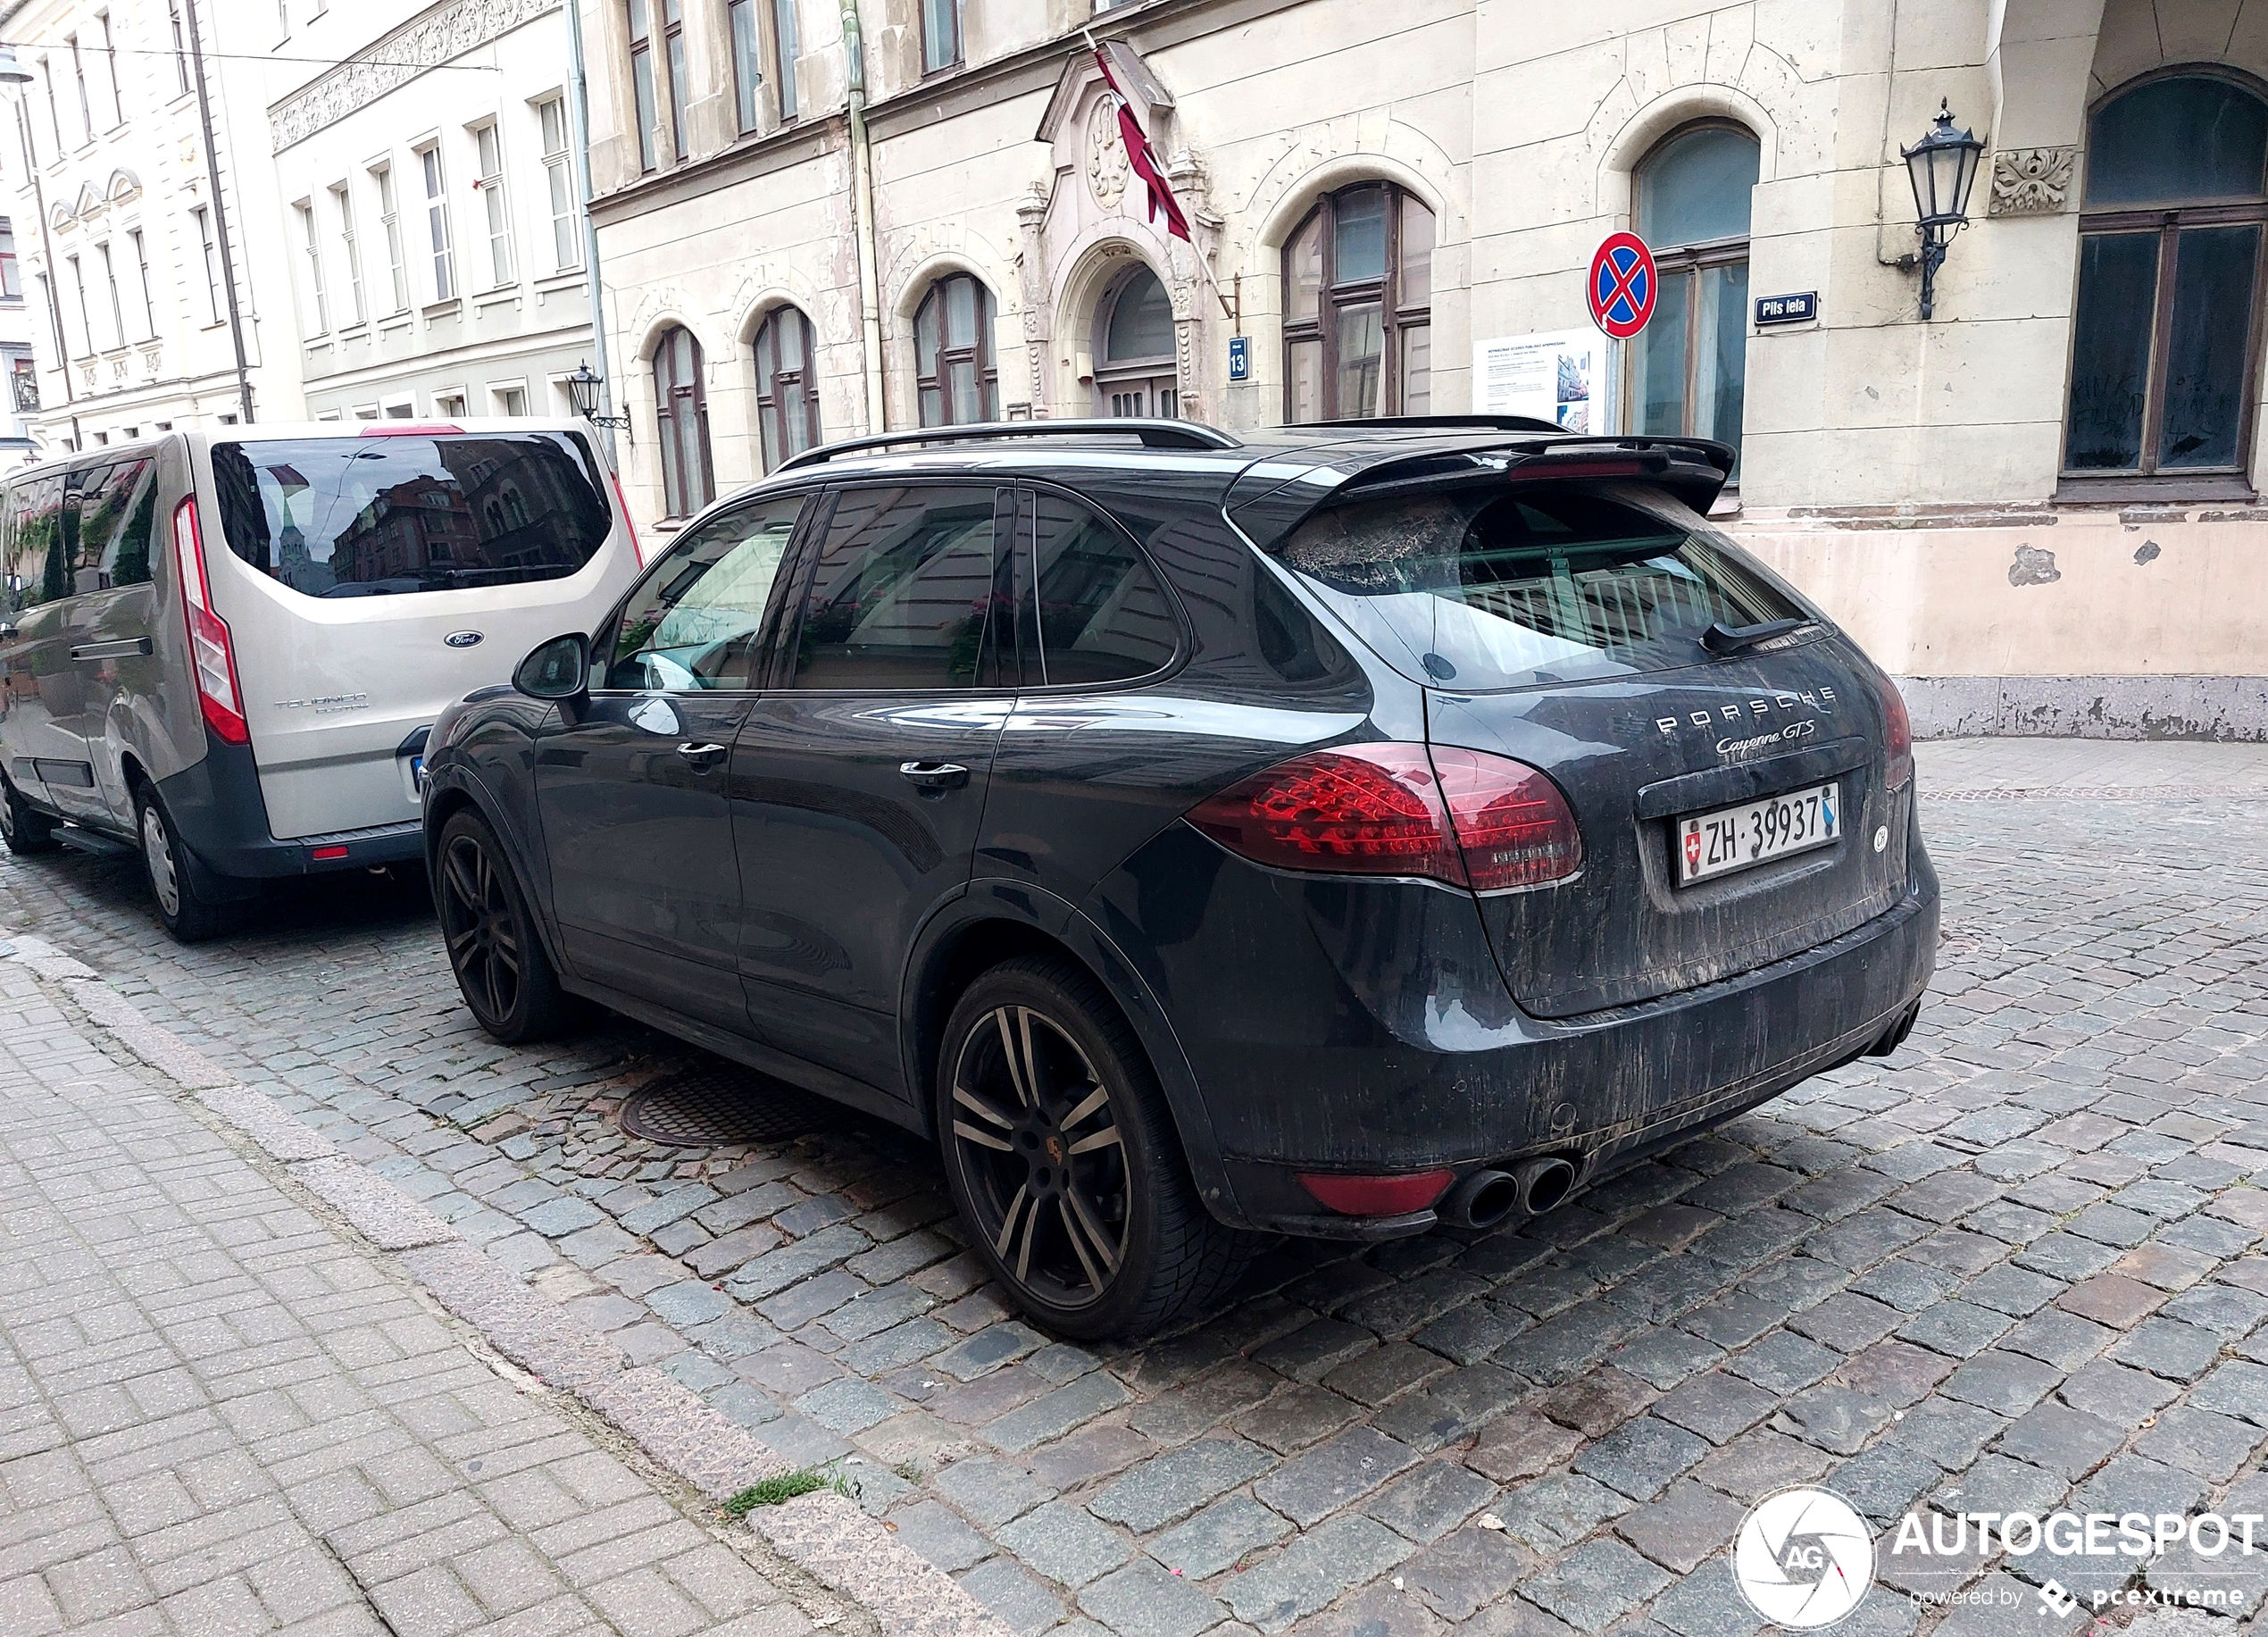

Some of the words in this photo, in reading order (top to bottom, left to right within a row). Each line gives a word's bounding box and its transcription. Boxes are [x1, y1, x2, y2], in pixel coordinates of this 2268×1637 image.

[1762, 301, 1784, 317] Pils
[1786, 298, 1805, 313] iela
[1230, 354, 1245, 372] 13
[1655, 686, 1837, 733] PORSCHE
[1716, 732, 1781, 759] Cayenne
[1782, 719, 1815, 738] GTS
